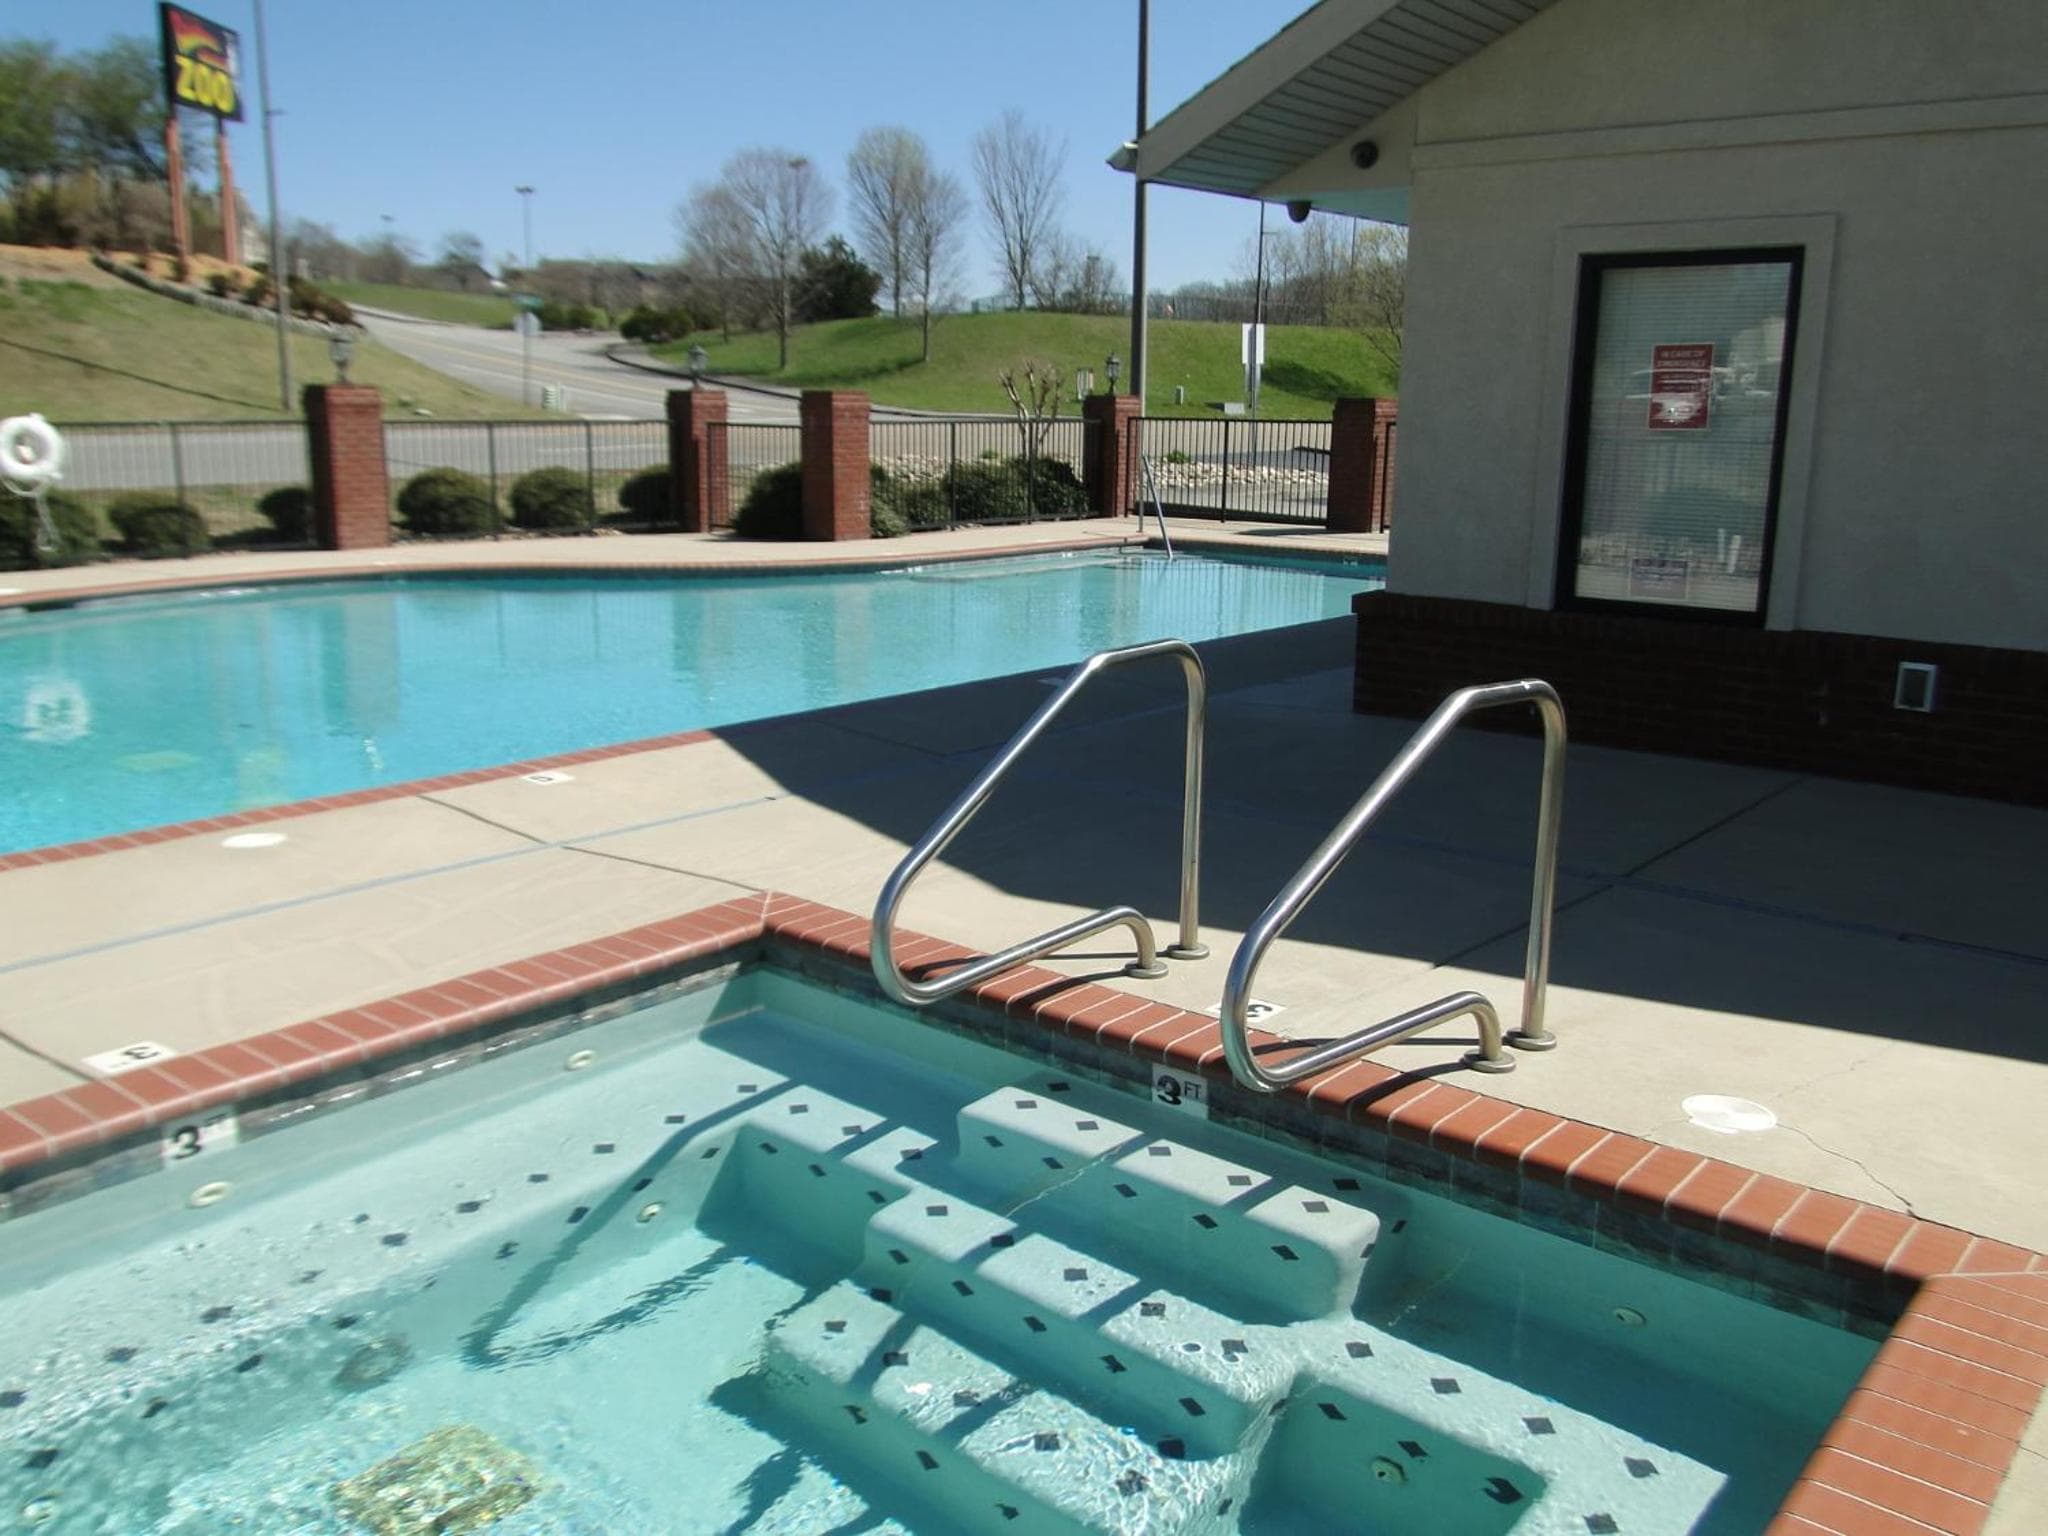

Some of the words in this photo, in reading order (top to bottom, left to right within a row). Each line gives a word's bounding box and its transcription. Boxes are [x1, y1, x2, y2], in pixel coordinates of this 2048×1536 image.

[174, 53, 235, 114] ZOO
[122, 1045, 160, 1061] 3
[1156, 1074, 1183, 1105] 3
[1183, 1080, 1202, 1100] FT
[171, 1123, 203, 1160] 3
